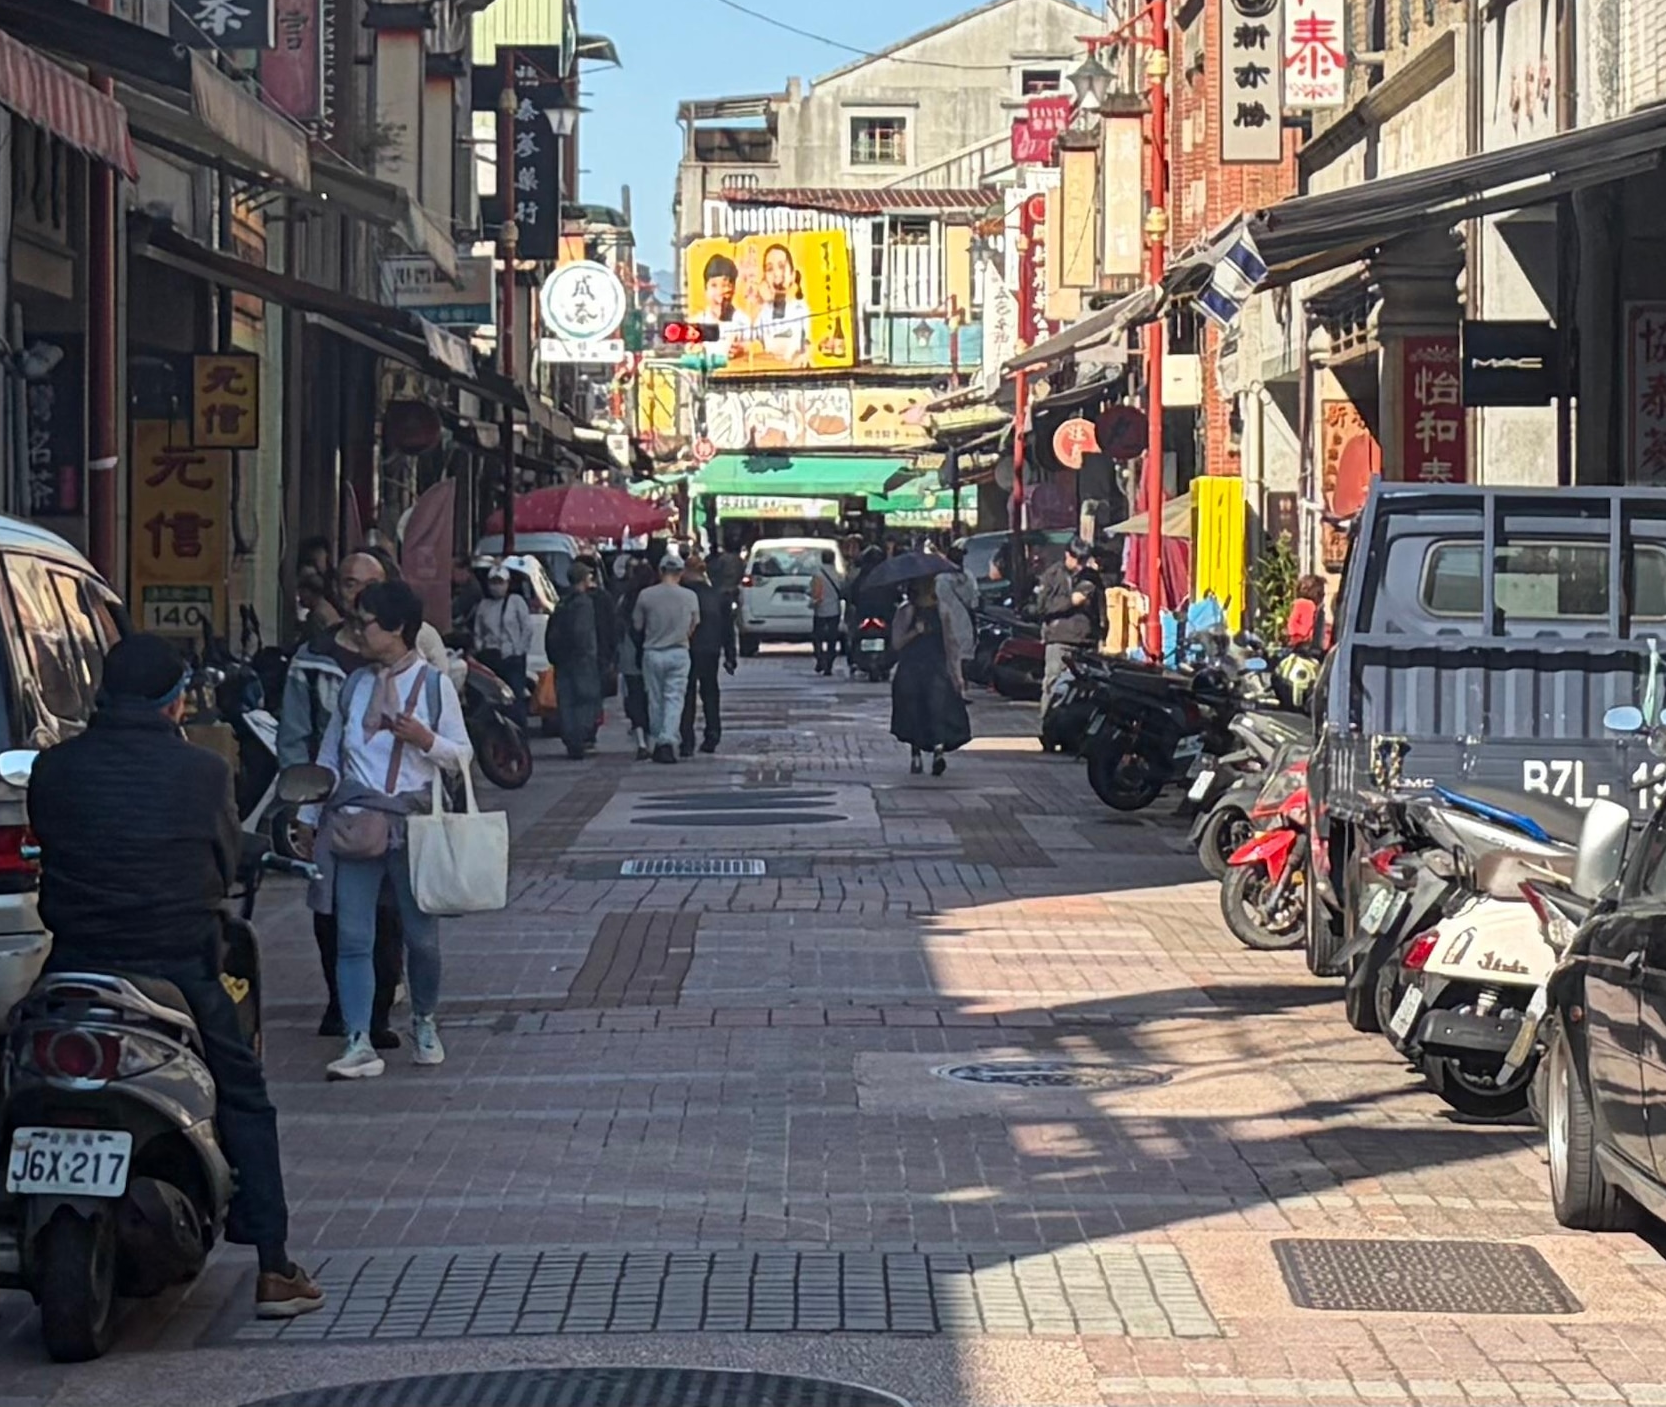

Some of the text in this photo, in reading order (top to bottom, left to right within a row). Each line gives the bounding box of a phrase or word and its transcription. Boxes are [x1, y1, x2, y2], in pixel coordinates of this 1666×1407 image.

[201, 365, 249, 435] 元信
[143, 445, 215, 560] 元信
[153, 606, 203, 627] 140
